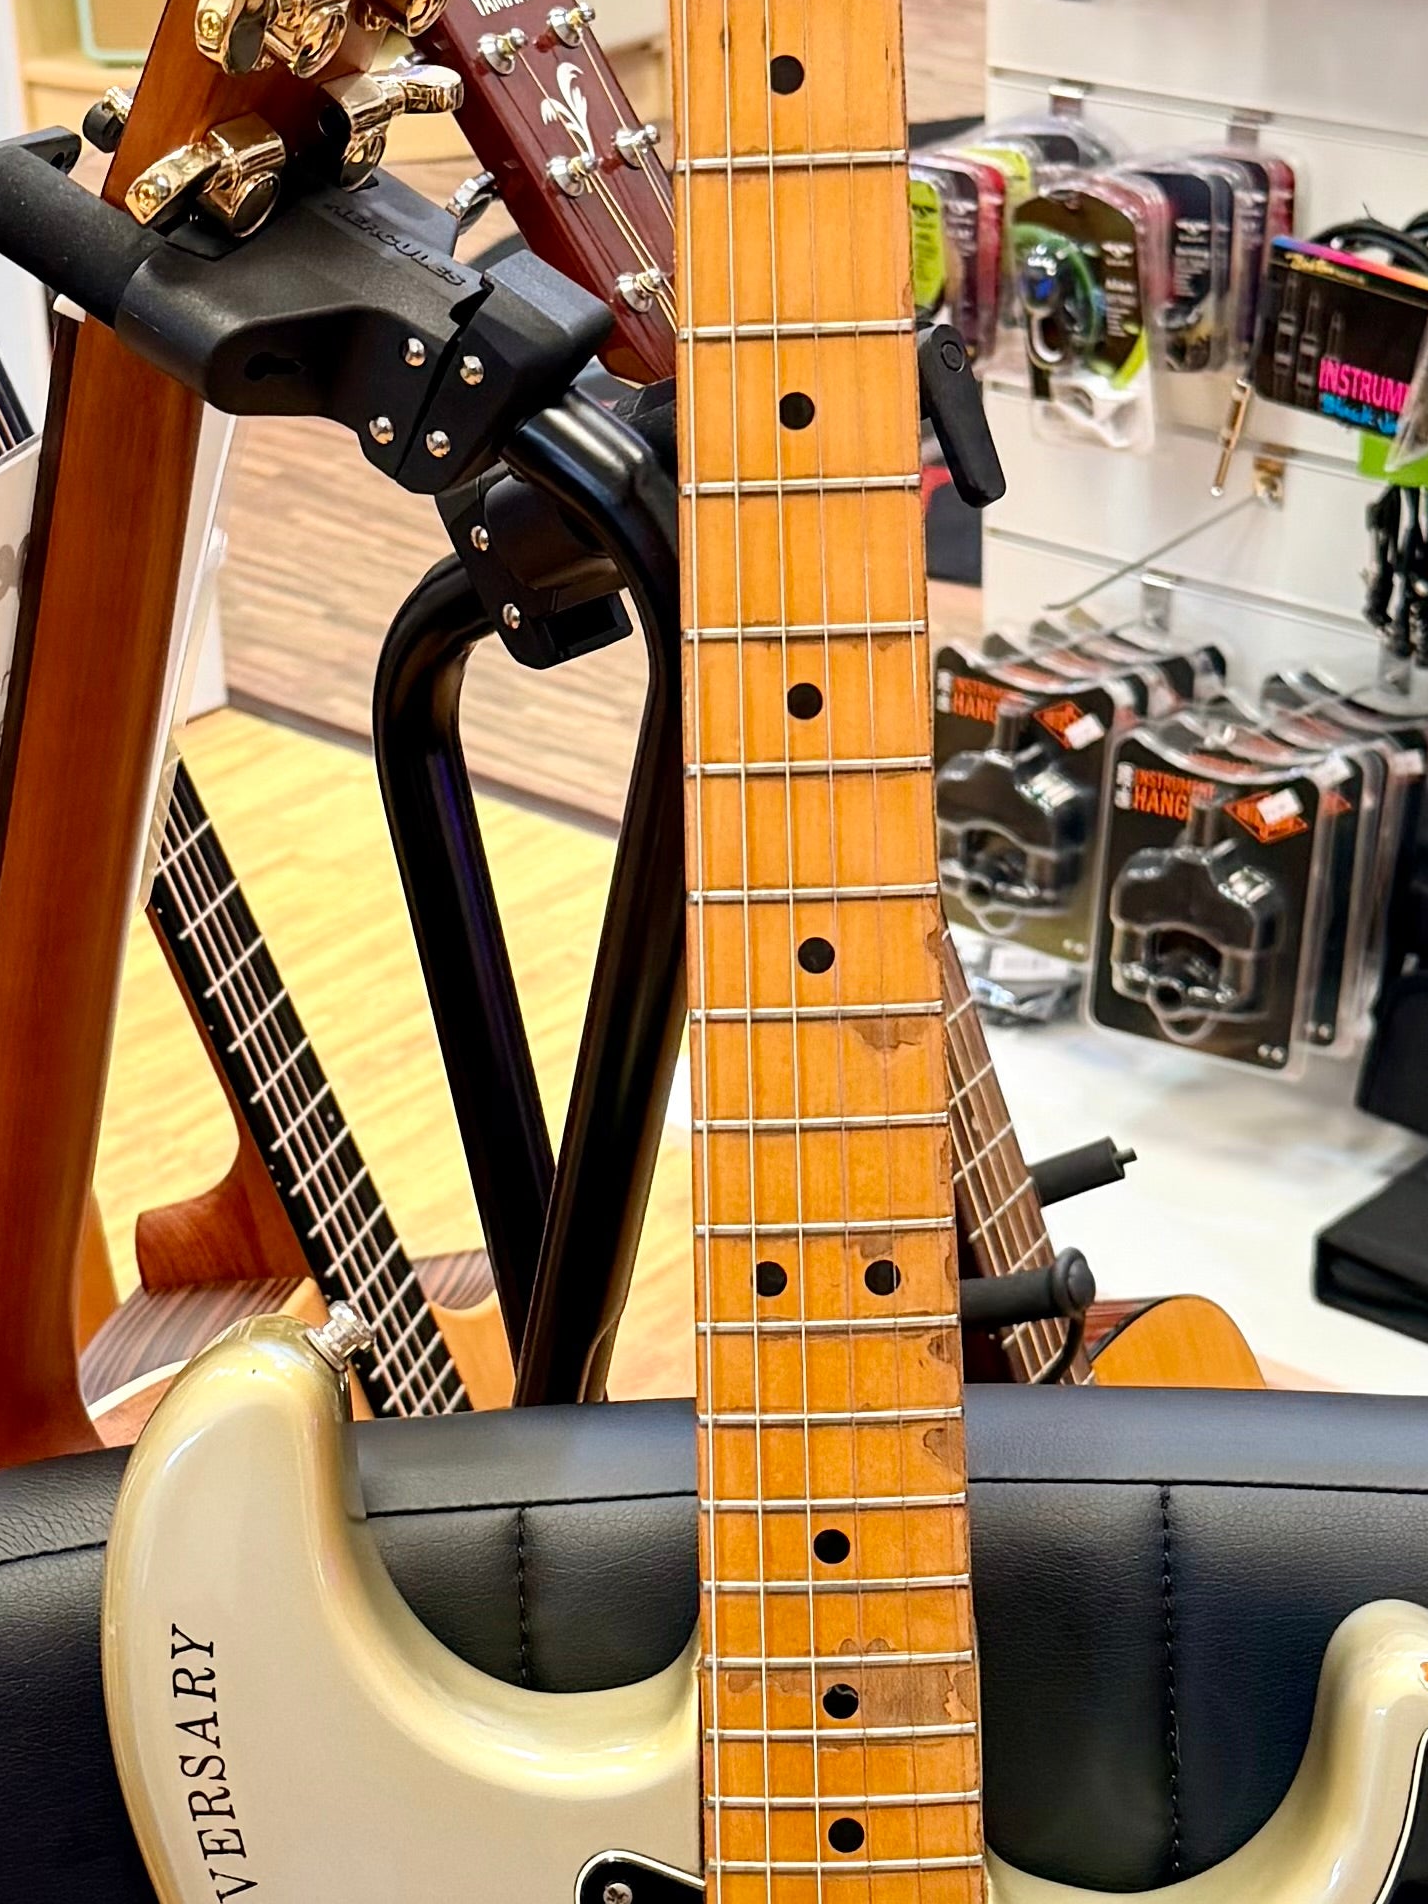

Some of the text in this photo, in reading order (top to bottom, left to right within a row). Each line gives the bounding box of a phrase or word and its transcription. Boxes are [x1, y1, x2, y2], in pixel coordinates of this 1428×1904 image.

[324, 202, 466, 287] HERCULES
[1318, 357, 1413, 414] INSTRUM
[1134, 786, 1193, 822] HANG
